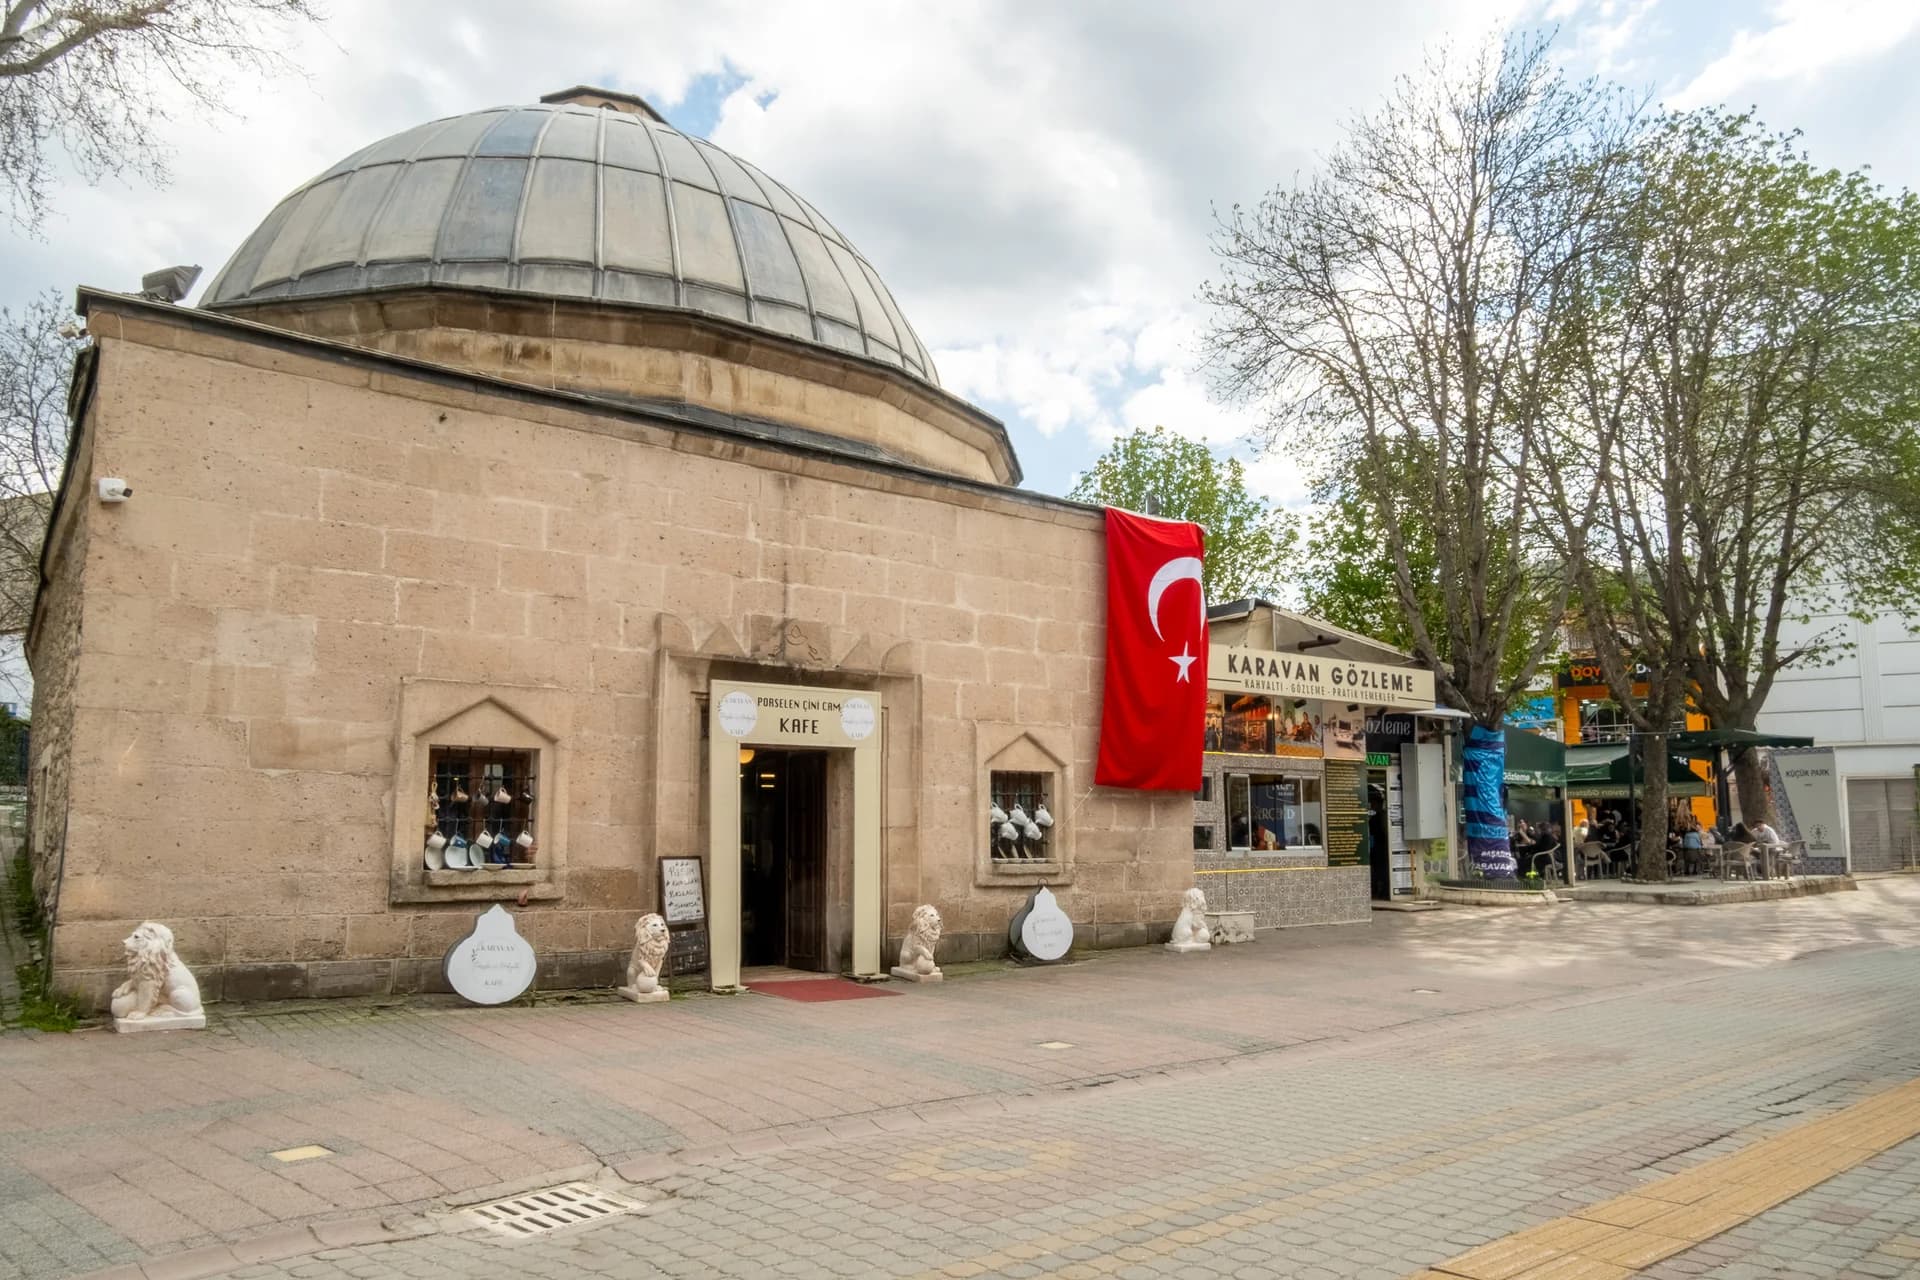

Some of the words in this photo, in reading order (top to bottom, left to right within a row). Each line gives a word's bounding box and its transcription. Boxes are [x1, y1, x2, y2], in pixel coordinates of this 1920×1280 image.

[1228, 654, 1320, 682] KARAVAN
[1331, 664, 1413, 692] GÖZLEME
[1244, 679, 1284, 692] KAHVALTI
[1291, 683, 1325, 696] GÖZLEME
[757, 697, 800, 709] PORSELEN
[822, 702, 841, 712] CAM
[780, 718, 819, 735] KAFE
[1366, 714, 1411, 735] özleme
[1365, 754, 1389, 766] AVAN
[1810, 768, 1830, 777] PARK
